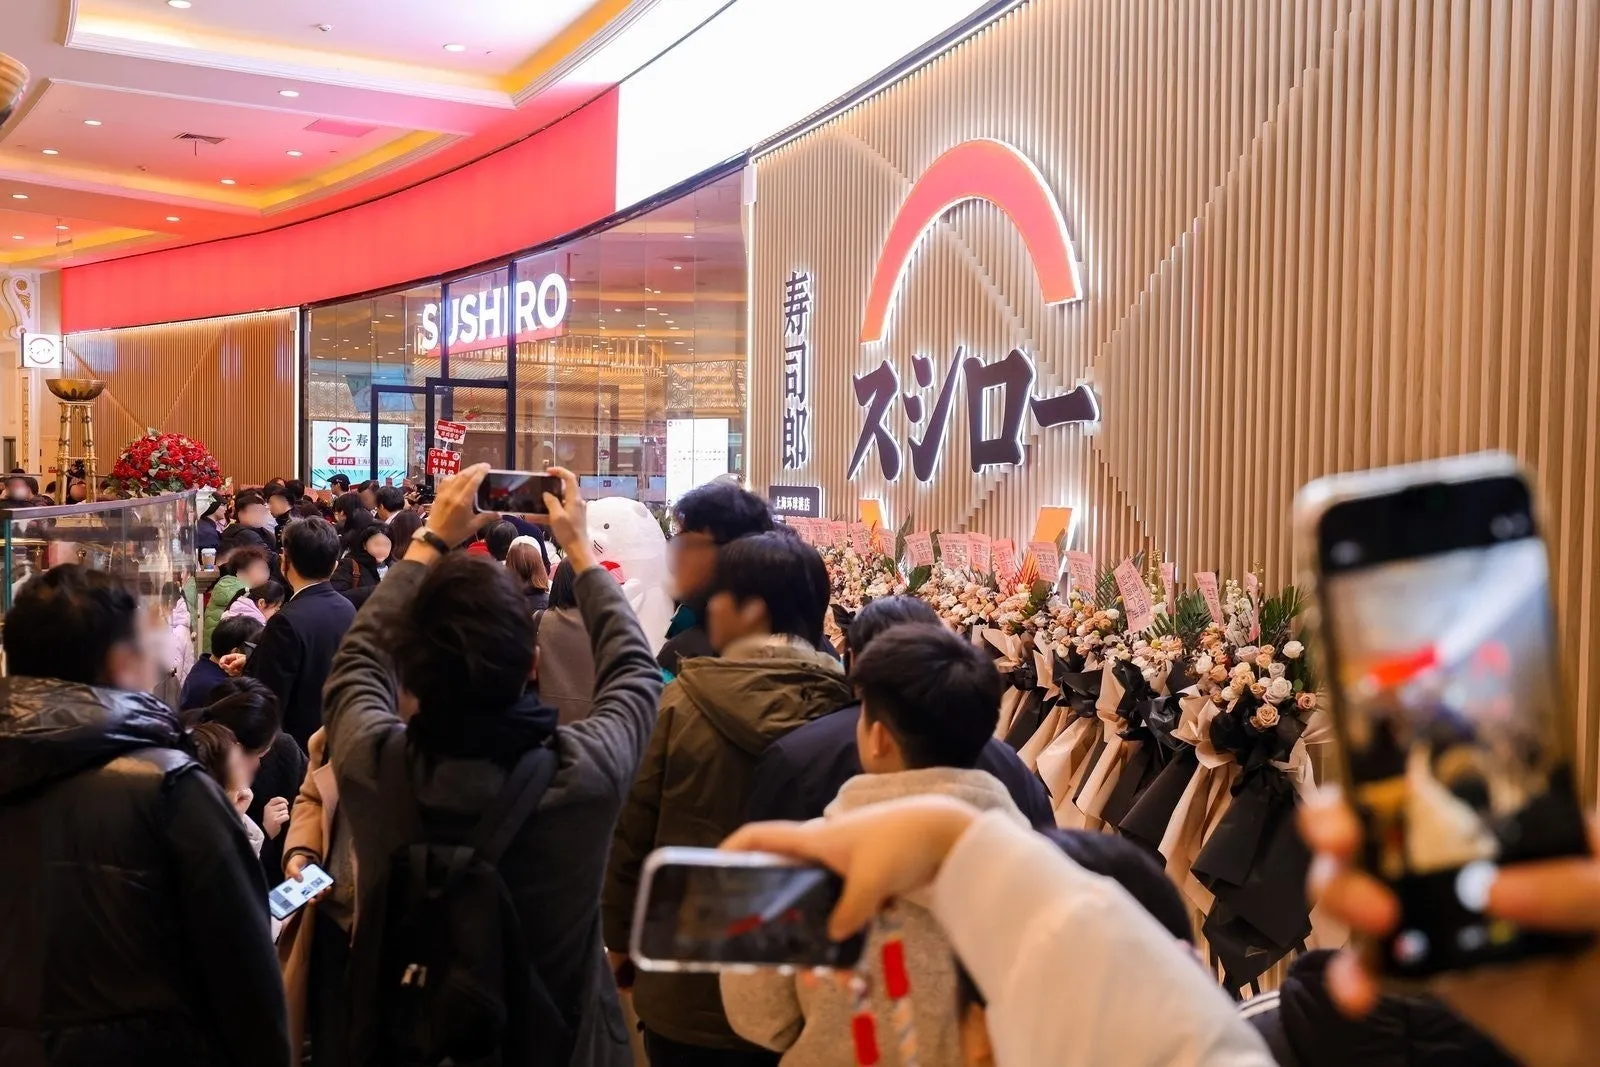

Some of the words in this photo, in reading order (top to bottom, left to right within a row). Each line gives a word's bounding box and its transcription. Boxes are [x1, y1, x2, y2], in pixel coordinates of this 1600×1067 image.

[422, 273, 568, 350] SUSHIRO
[783, 270, 812, 469] 寿司郎
[847, 345, 1099, 482] スシロー
[356, 433, 393, 448] 寿郎
